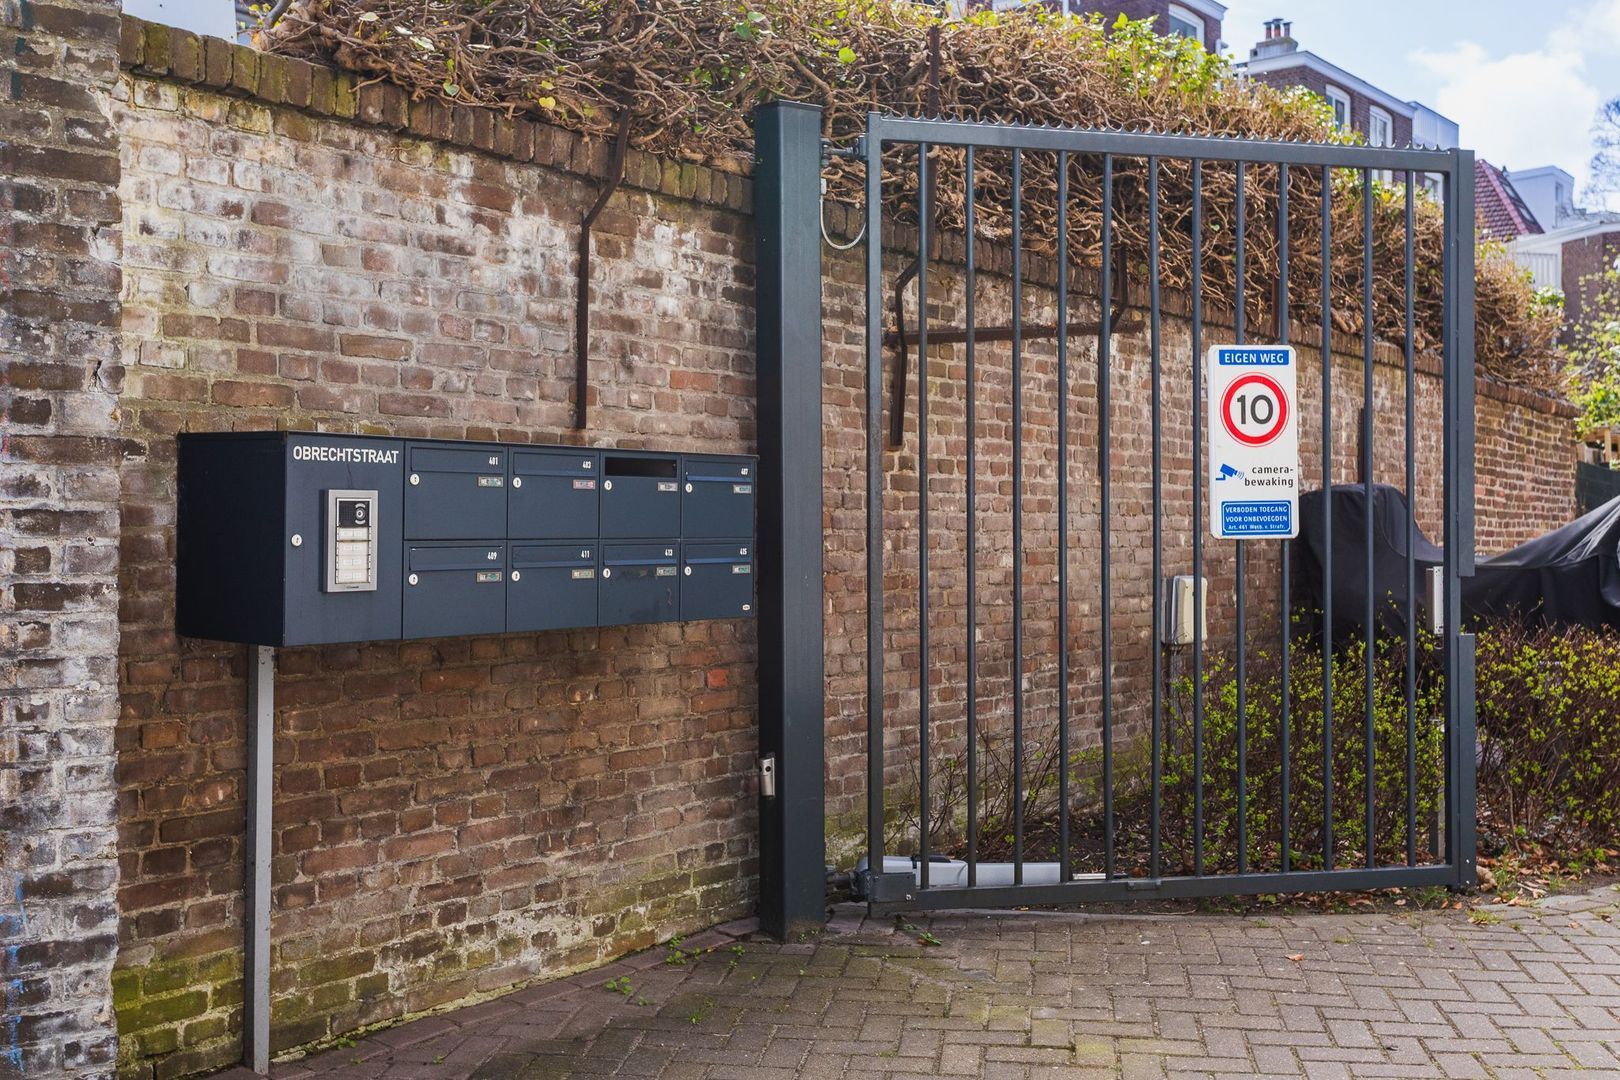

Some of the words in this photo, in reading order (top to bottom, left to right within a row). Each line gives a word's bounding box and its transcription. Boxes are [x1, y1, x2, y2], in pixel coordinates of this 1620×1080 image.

[1224, 353, 1257, 363] EIGEN
[1260, 353, 1284, 363] WEG
[1236, 394, 1274, 425] 10
[293, 445, 399, 464] OBRECHTSTRAAT
[488, 456, 499, 465] 401
[1251, 466, 1294, 474] camera-
[1244, 477, 1294, 488] bewaking
[1243, 515, 1288, 523] ONBEVOEGDEN
[487, 551, 498, 560] 409
[580, 550, 590, 559] 411
